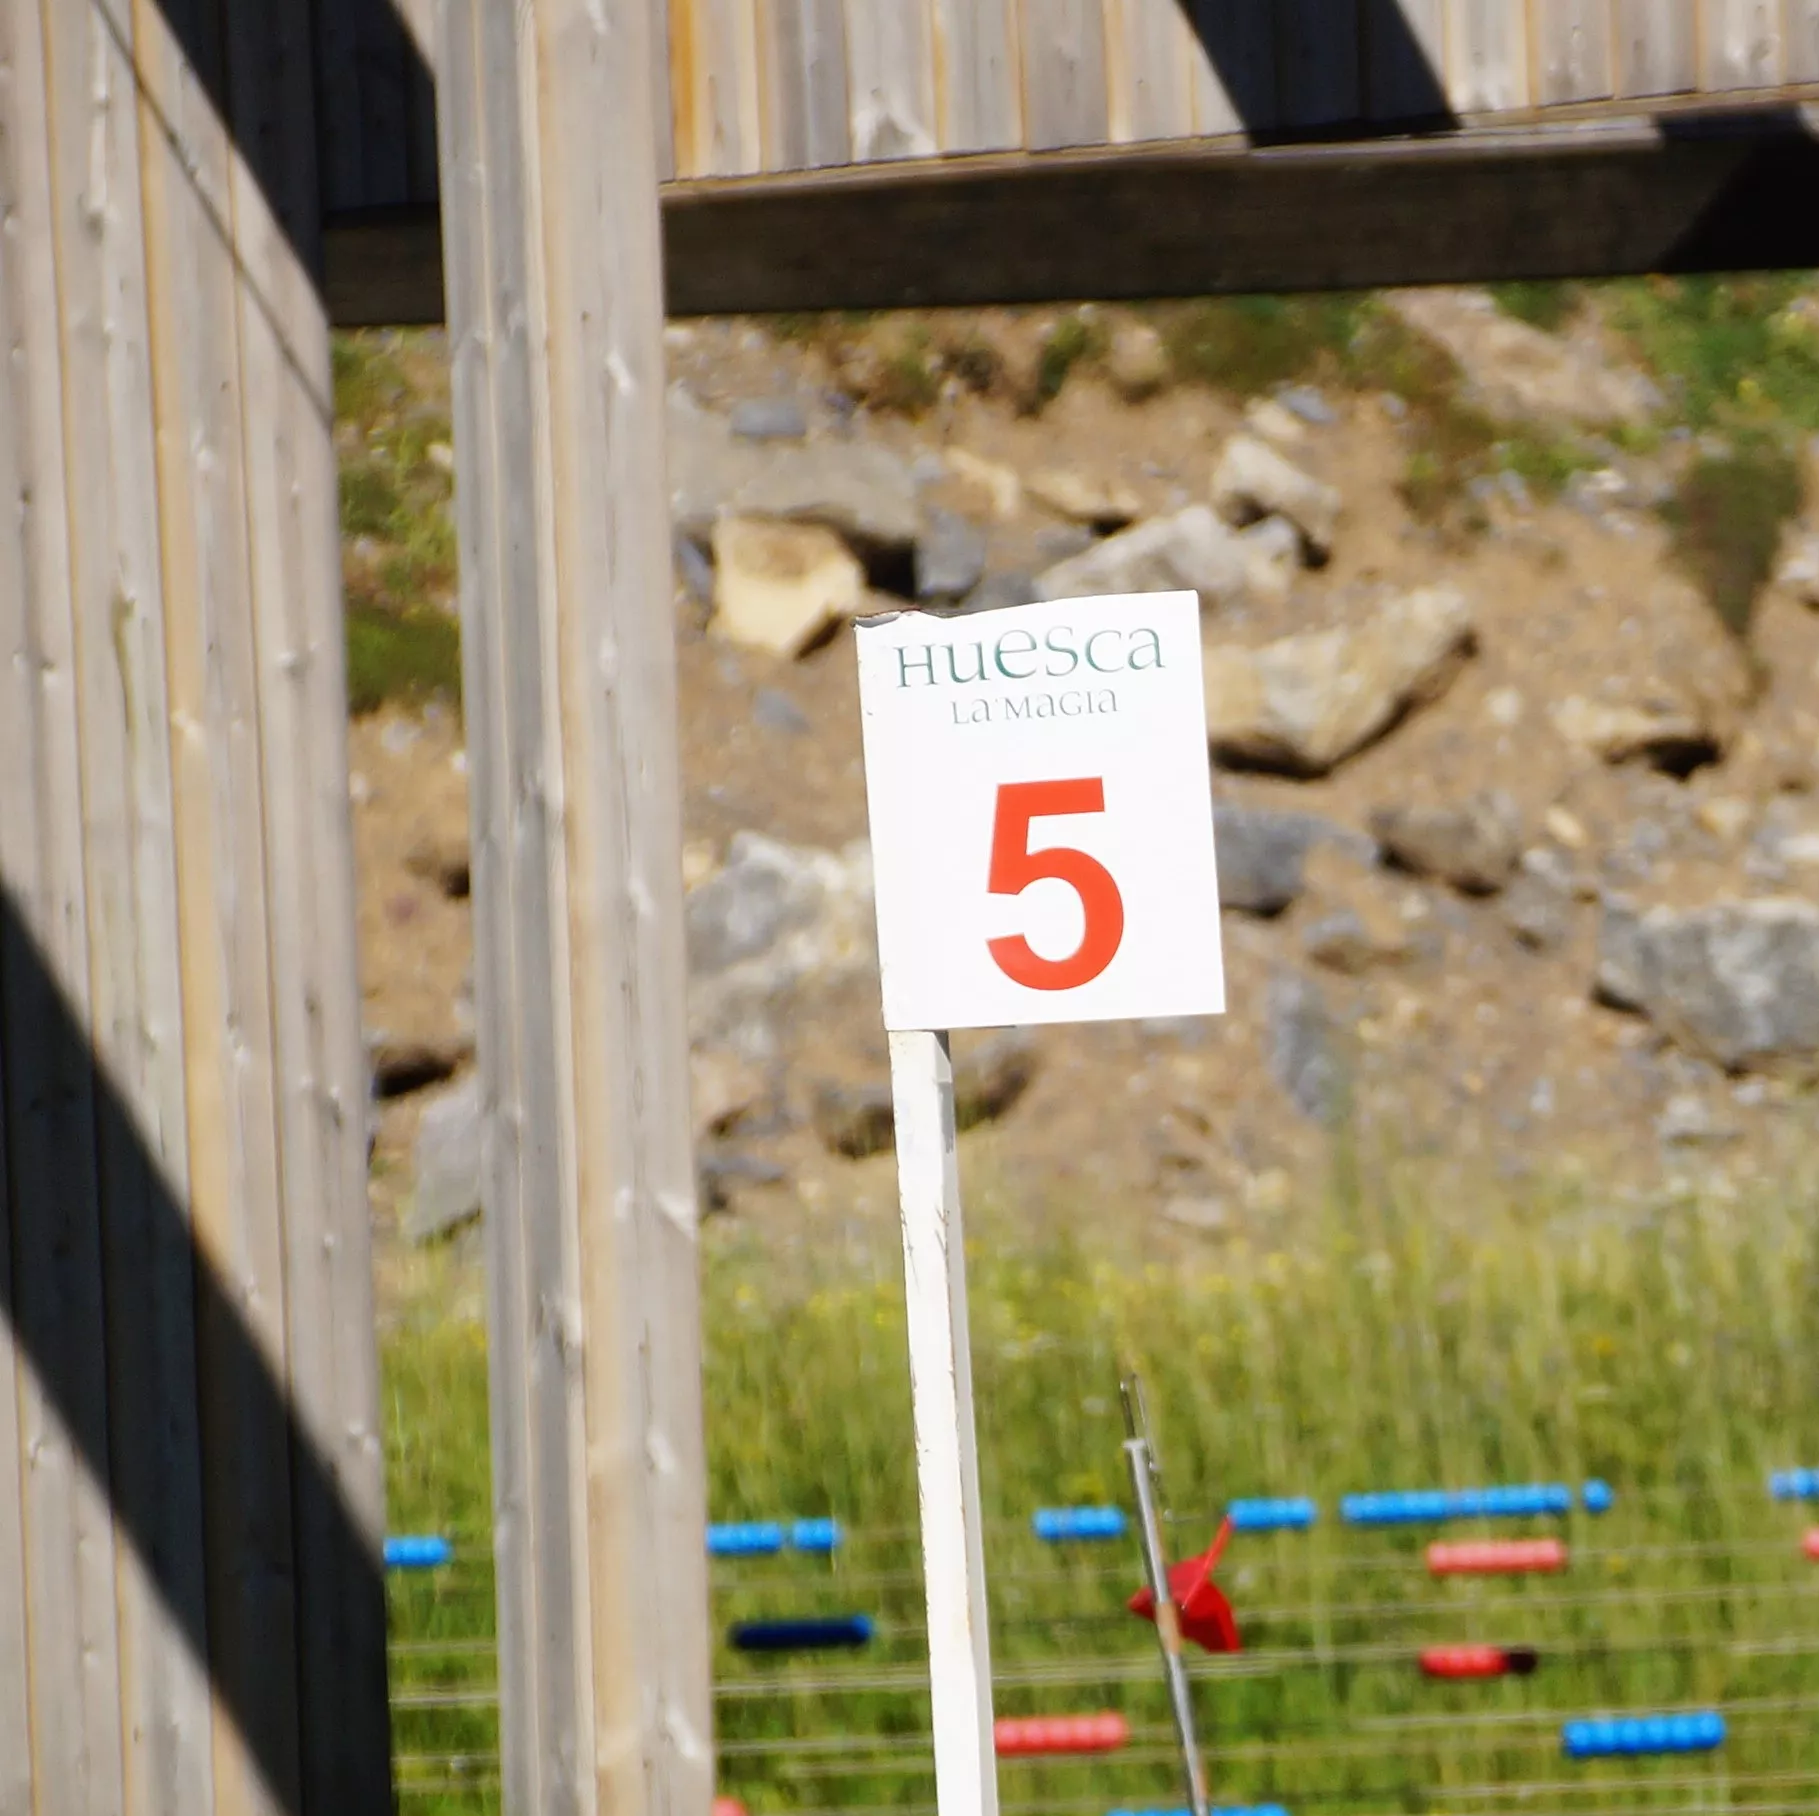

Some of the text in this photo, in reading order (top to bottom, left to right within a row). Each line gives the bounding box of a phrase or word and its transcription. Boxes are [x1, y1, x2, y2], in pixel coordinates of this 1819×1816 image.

[894, 624, 1166, 689] Huesca
[951, 698, 993, 725] La
[985, 776, 1125, 991] 5
